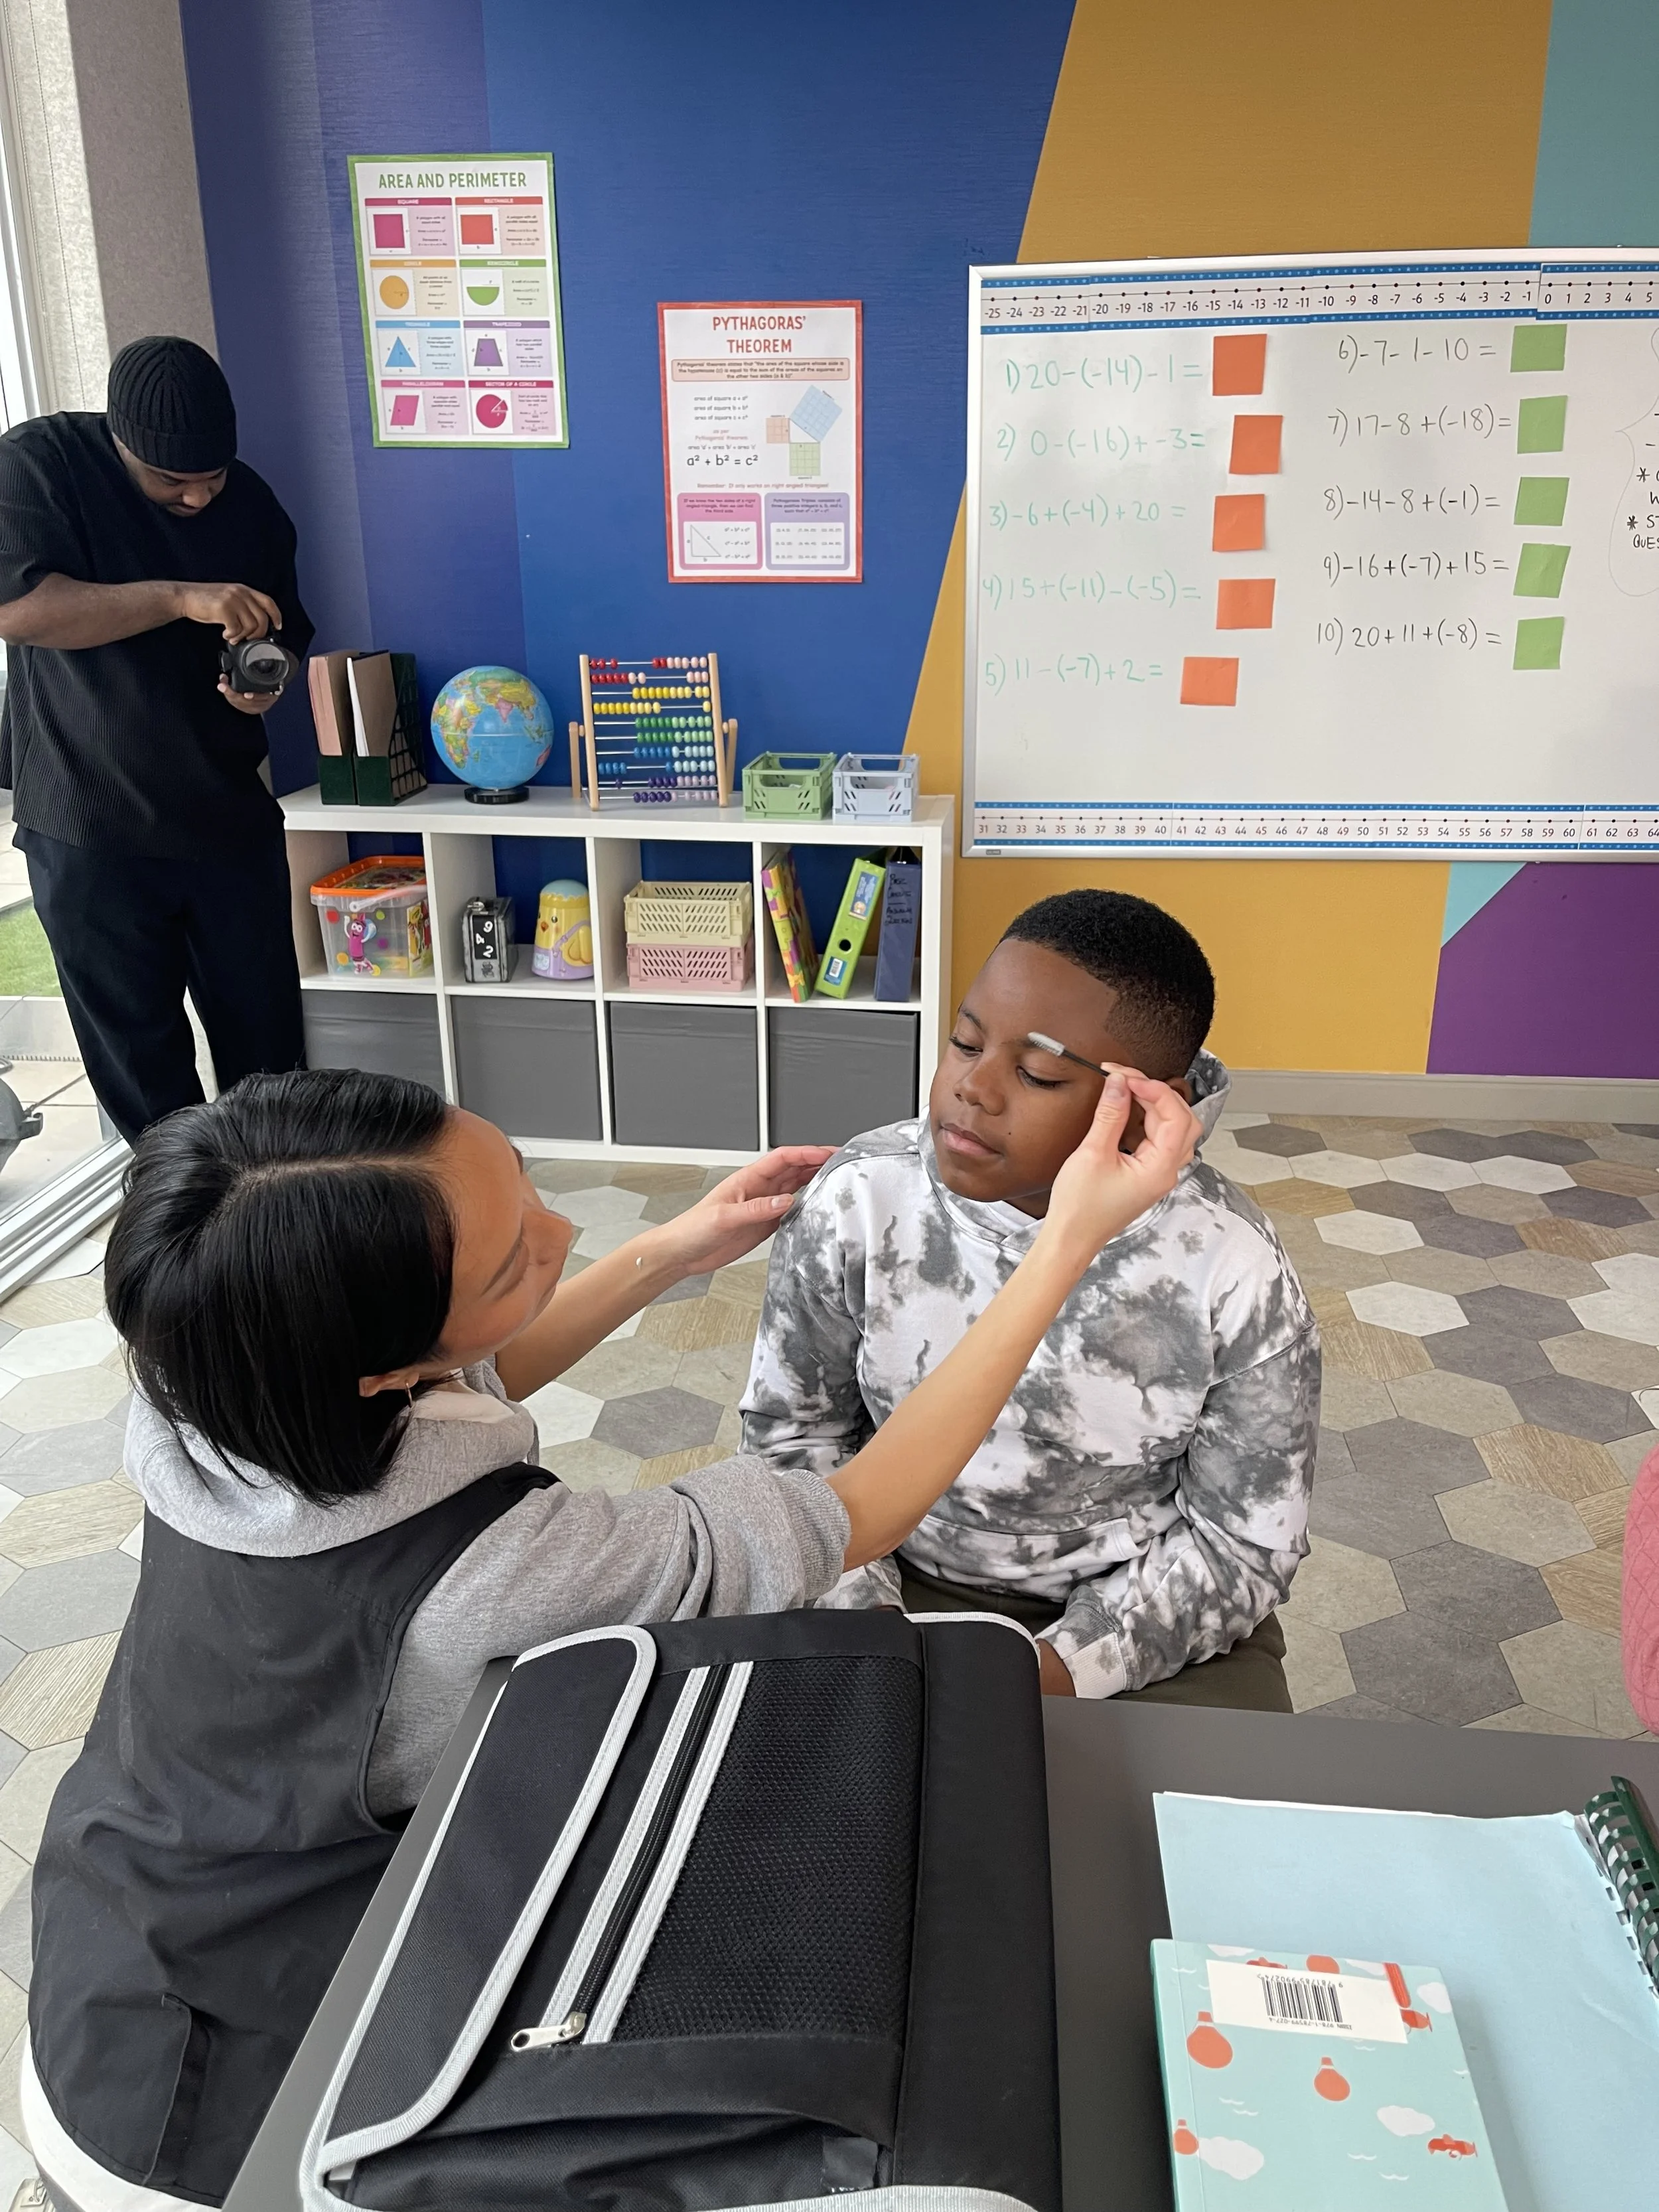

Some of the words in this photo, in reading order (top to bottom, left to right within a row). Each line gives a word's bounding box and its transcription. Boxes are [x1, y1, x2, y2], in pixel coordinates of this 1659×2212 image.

[379, 173, 413, 189] AREA
[417, 173, 445, 188] AND
[449, 172, 527, 188] PERIMETER
[984, 307, 1001, 319] -25
[1006, 307, 1023, 318] -24
[1029, 306, 1045, 317] -23
[1050, 305, 1066, 317] -22
[1072, 305, 1087, 316] -21
[1092, 303, 1109, 315] -20
[1115, 303, 1131, 314] -19
[1137, 302, 1153, 313] -18
[1159, 301, 1176, 312] -17
[1183, 300, 1198, 311] -16
[1205, 300, 1221, 311] -15
[1228, 299, 1243, 310] -14
[1250, 298, 1266, 309] -13
[1273, 297, 1289, 309] -12
[1295, 297, 1309, 308] -11
[1318, 295, 1334, 307] -10
[1345, 295, 1356, 306] -9
[1368, 294, 1378, 305] -8
[1390, 293, 1401, 305] -7
[1411, 293, 1423, 304] -6
[1434, 293, 1445, 303] -5
[1456, 292, 1467, 303] -4
[1479, 291, 1488, 303] -3
[1500, 291, 1510, 302] -2
[1522, 291, 1531, 301] -1
[1544, 293, 1551, 305] 0
[1567, 293, 1571, 304] 1
[1583, 293, 1591, 304] 2
[1604, 292, 1611, 303] 3
[1624, 292, 1632, 303] 4
[1646, 291, 1652, 303] 5
[712, 315, 807, 331] PYTHAGORAS'
[727, 338, 792, 354] THEOREM
[687, 455, 700, 466] a²
[715, 453, 730, 466] b²
[745, 454, 758, 466] c²
[979, 824, 988, 834] 31
[996, 824, 1007, 834] 32
[1016, 824, 1027, 834] 33
[1035, 824, 1046, 834] 34
[1055, 825, 1066, 834] 35
[1075, 825, 1086, 834] 36
[1094, 825, 1106, 834] 37
[1114, 825, 1126, 834] 38
[1135, 825, 1146, 834] 39
[1154, 826, 1167, 834] 40
[1176, 826, 1187, 834] 41
[1194, 826, 1206, 835] 42
[1214, 826, 1226, 835] 43
[1234, 826, 1246, 835] 44
[1255, 826, 1267, 836] 45
[1275, 826, 1287, 835] 46
[1296, 826, 1309, 835] 47
[1316, 826, 1329, 836] 48
[1336, 826, 1349, 836] 49
[1357, 826, 1370, 836] 50
[1378, 826, 1388, 836] 51
[1396, 826, 1408, 836] 52
[1417, 826, 1429, 836] 53
[1437, 827, 1449, 836] 54
[1459, 827, 1471, 837] 55
[1479, 828, 1491, 837] 56
[1500, 828, 1513, 837] 57
[1521, 828, 1534, 838] 58
[1542, 828, 1554, 838] 59
[1563, 828, 1575, 838] 60
[1586, 828, 1597, 837] 61
[1605, 828, 1618, 837] 62
[1626, 828, 1639, 838] 63
[1648, 828, 1659, 838] 64
[483, 921, 494, 933] 9
[482, 945, 494, 958] 2
